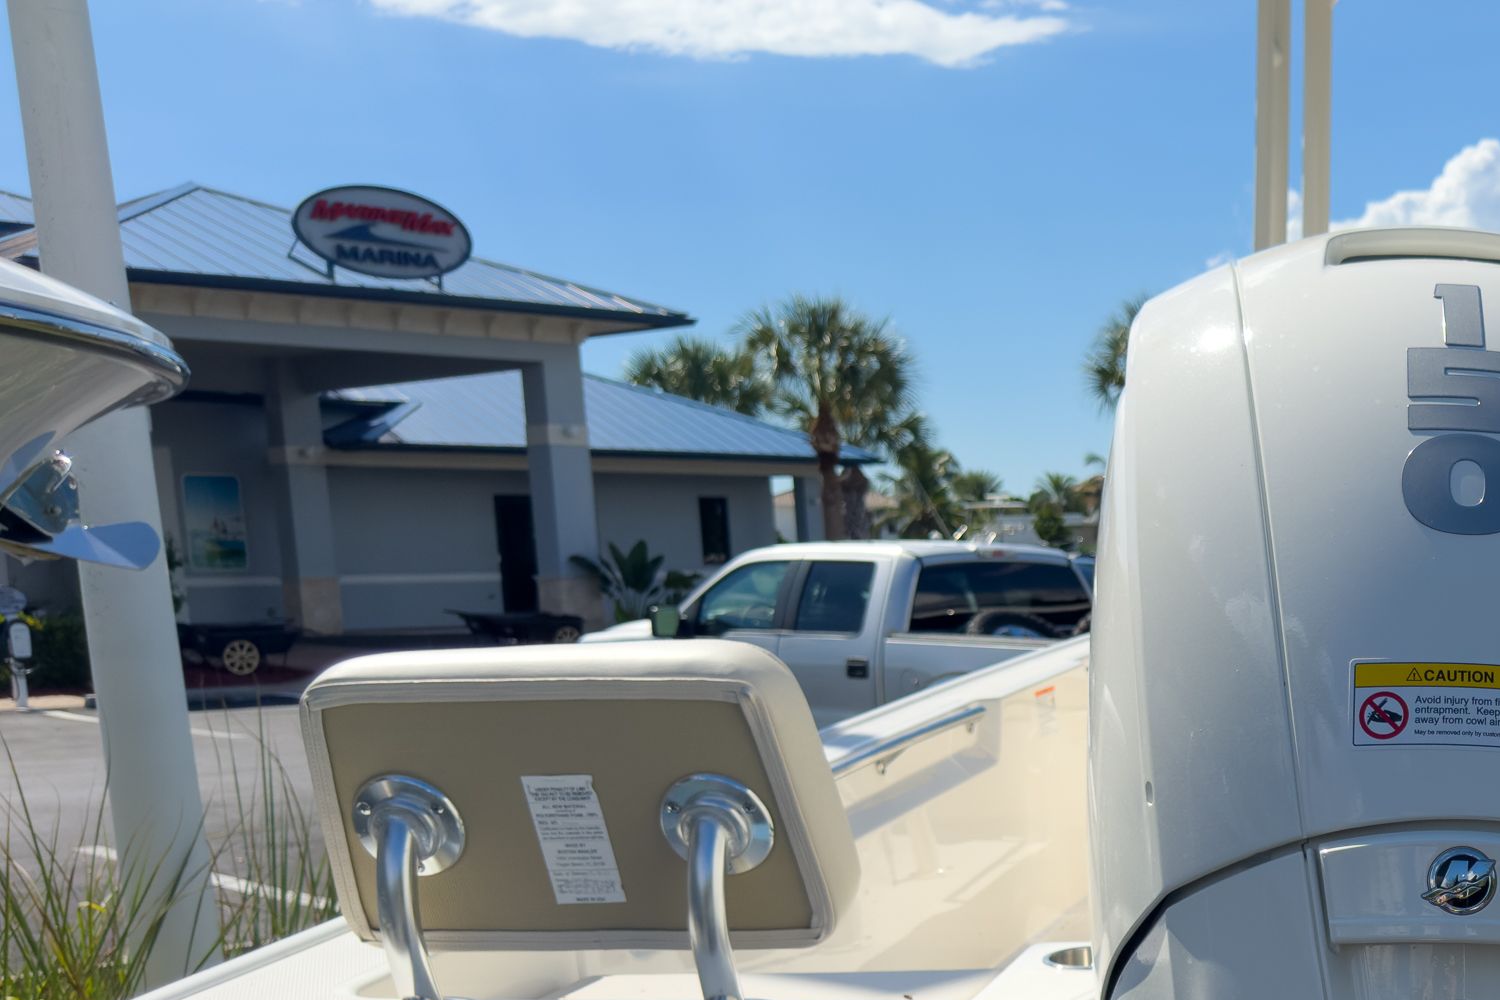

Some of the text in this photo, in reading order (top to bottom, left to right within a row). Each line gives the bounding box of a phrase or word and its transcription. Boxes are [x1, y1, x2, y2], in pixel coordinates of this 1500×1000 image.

[336, 244, 439, 268] MARINA
[1424, 669, 1495, 684] CAUTION
[1415, 695, 1441, 704] Avoid
[1444, 695, 1469, 707] injury
[1471, 696, 1493, 706] from
[1415, 706, 1471, 715] entrapment.
[1476, 706, 1500, 717] Keep
[1415, 717, 1440, 725] away
[1442, 715, 1463, 724] from
[1465, 717, 1487, 725] cowl
[1489, 718, 1500, 726] air
[1474, 730, 1482, 738] by
